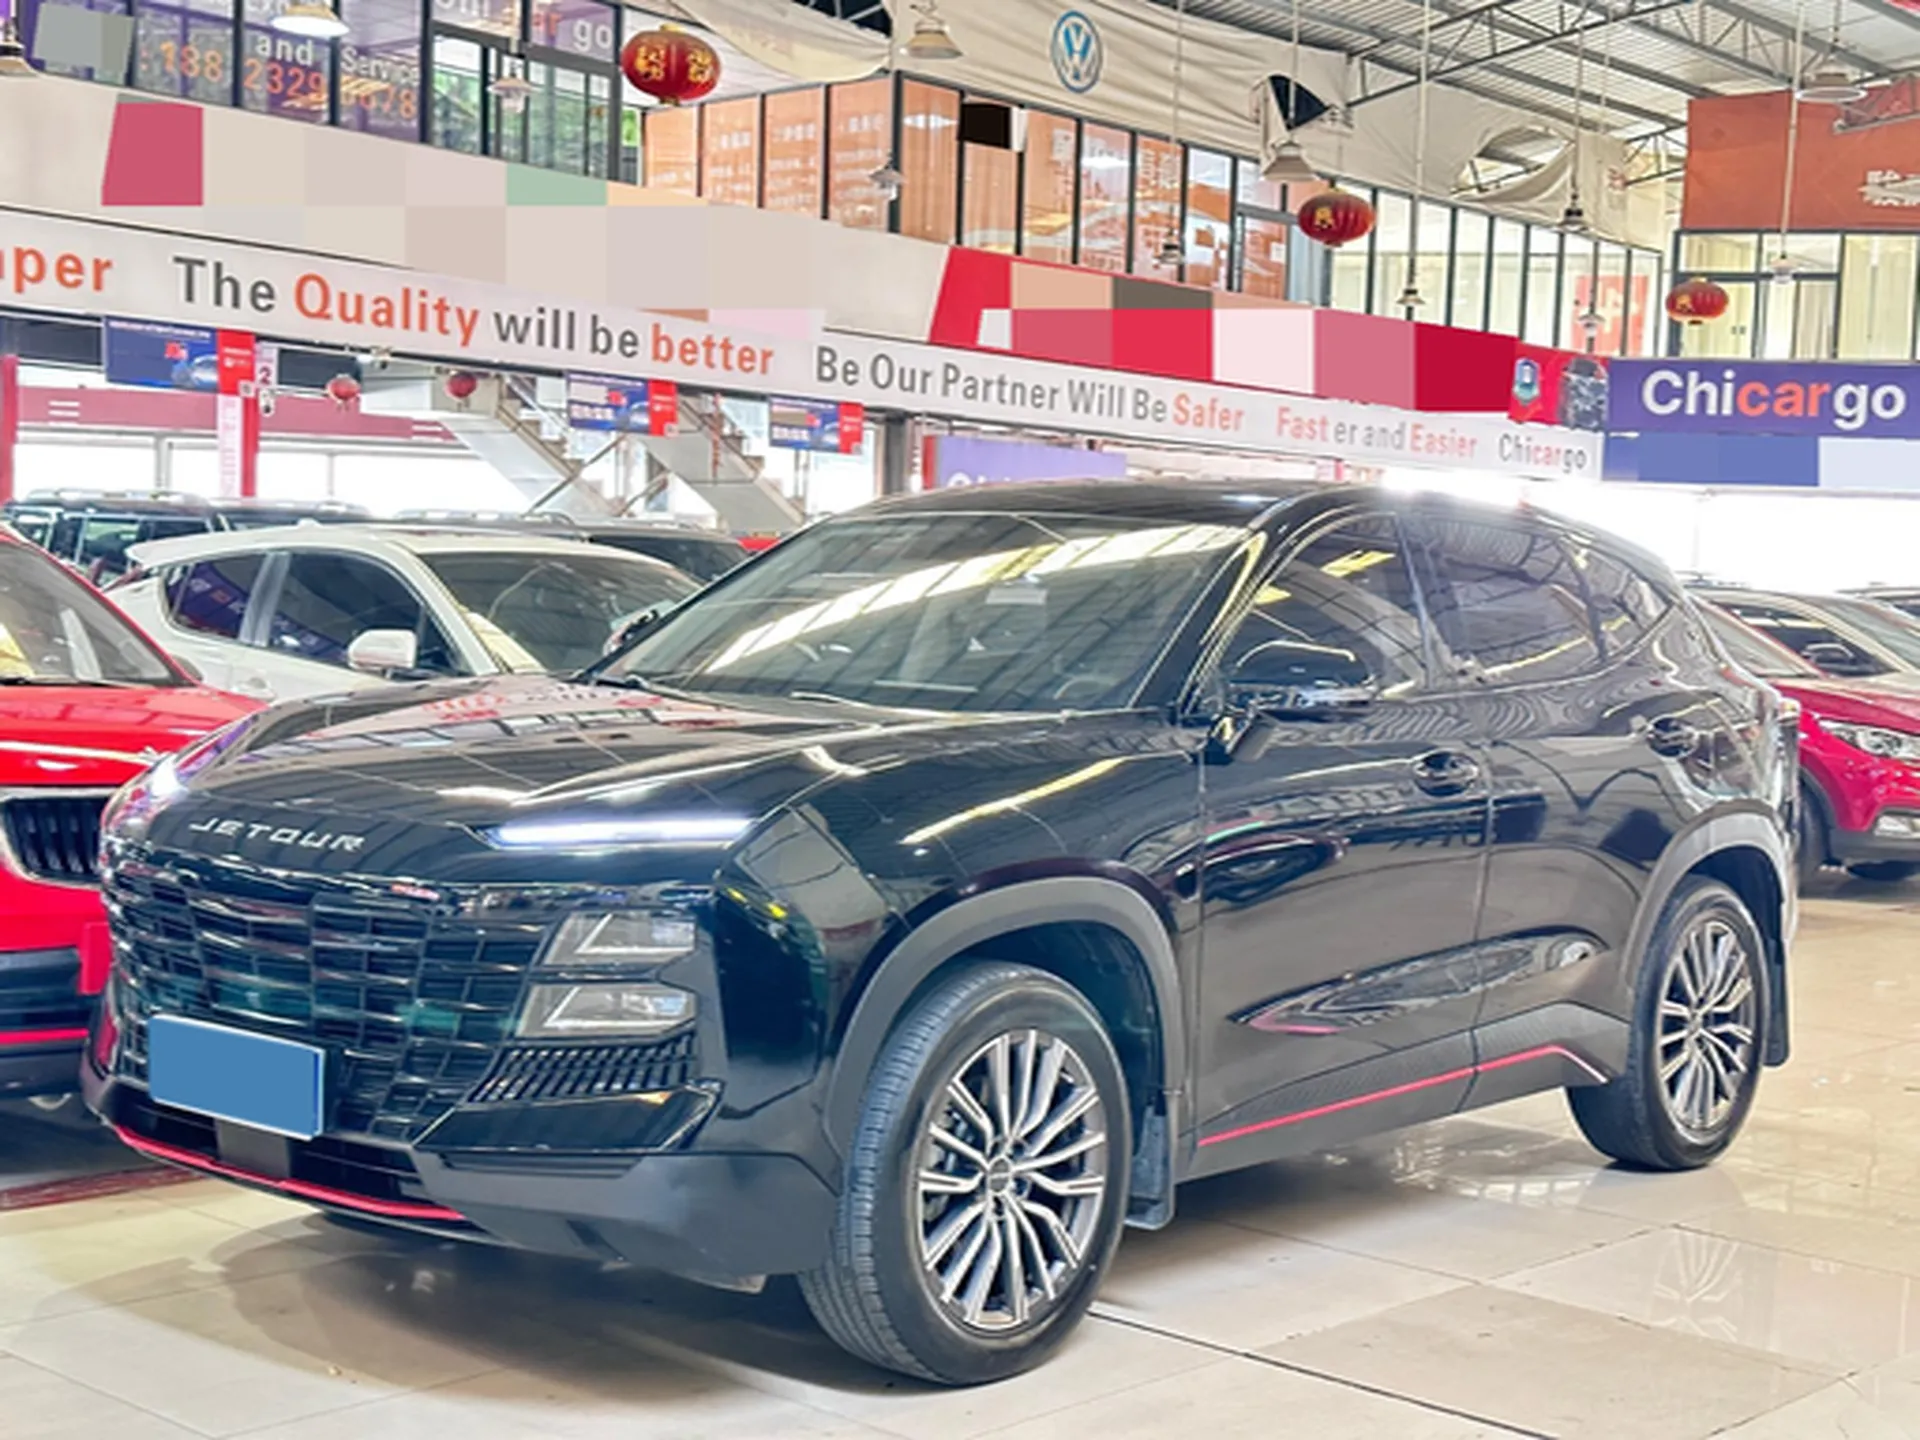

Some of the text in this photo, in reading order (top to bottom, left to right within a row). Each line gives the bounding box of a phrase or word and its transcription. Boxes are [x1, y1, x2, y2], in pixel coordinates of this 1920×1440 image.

[256, 35, 313, 66] and
[0, 246, 775, 375] per The Quality will be better
[815, 345, 1245, 431] Be Our Partner Will Be Safer
[1641, 368, 1907, 432] Chicargo
[1361, 421, 1407, 450] and
[1409, 422, 1478, 458] Easier
[1499, 432, 1588, 475] Chicargo
[187, 817, 365, 853] JETOUR
